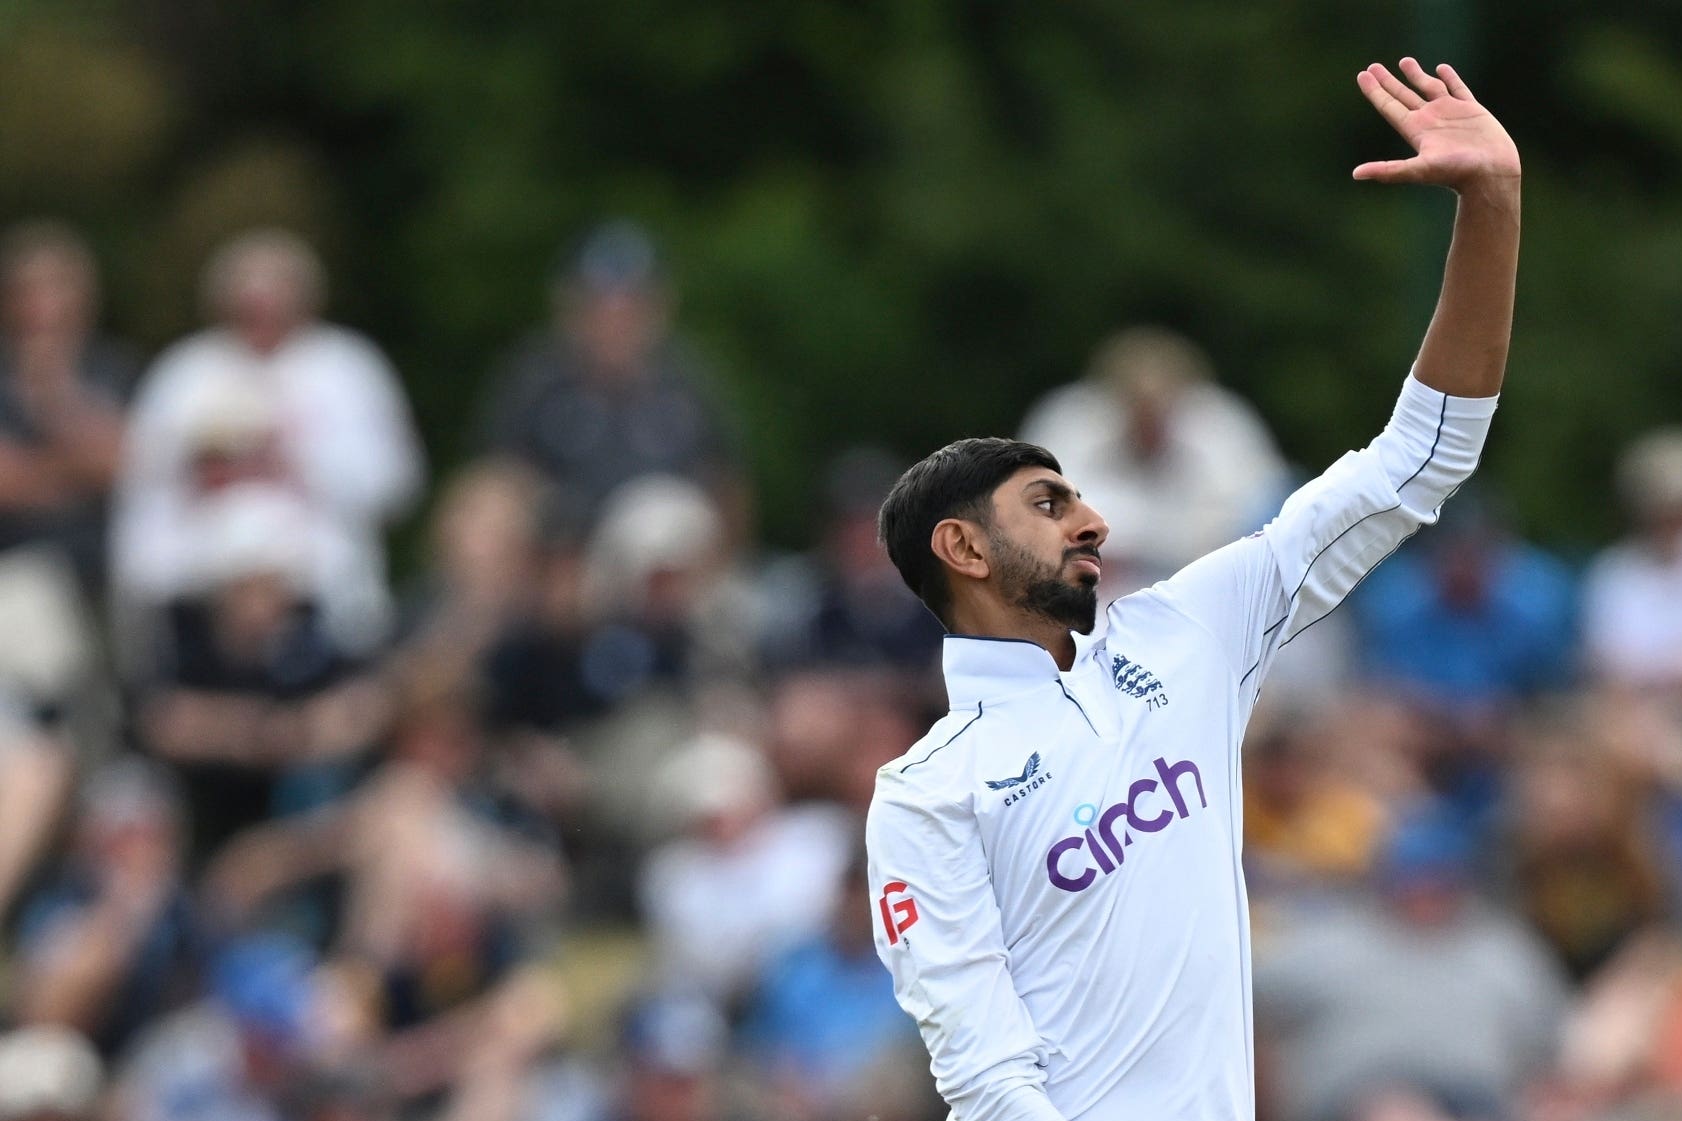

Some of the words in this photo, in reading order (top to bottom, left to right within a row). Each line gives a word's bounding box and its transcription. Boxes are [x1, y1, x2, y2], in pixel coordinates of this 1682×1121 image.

[1146, 693, 1169, 712] 713
[1004, 771, 1053, 807] CASTORE
[1046, 756, 1207, 893] cinch
